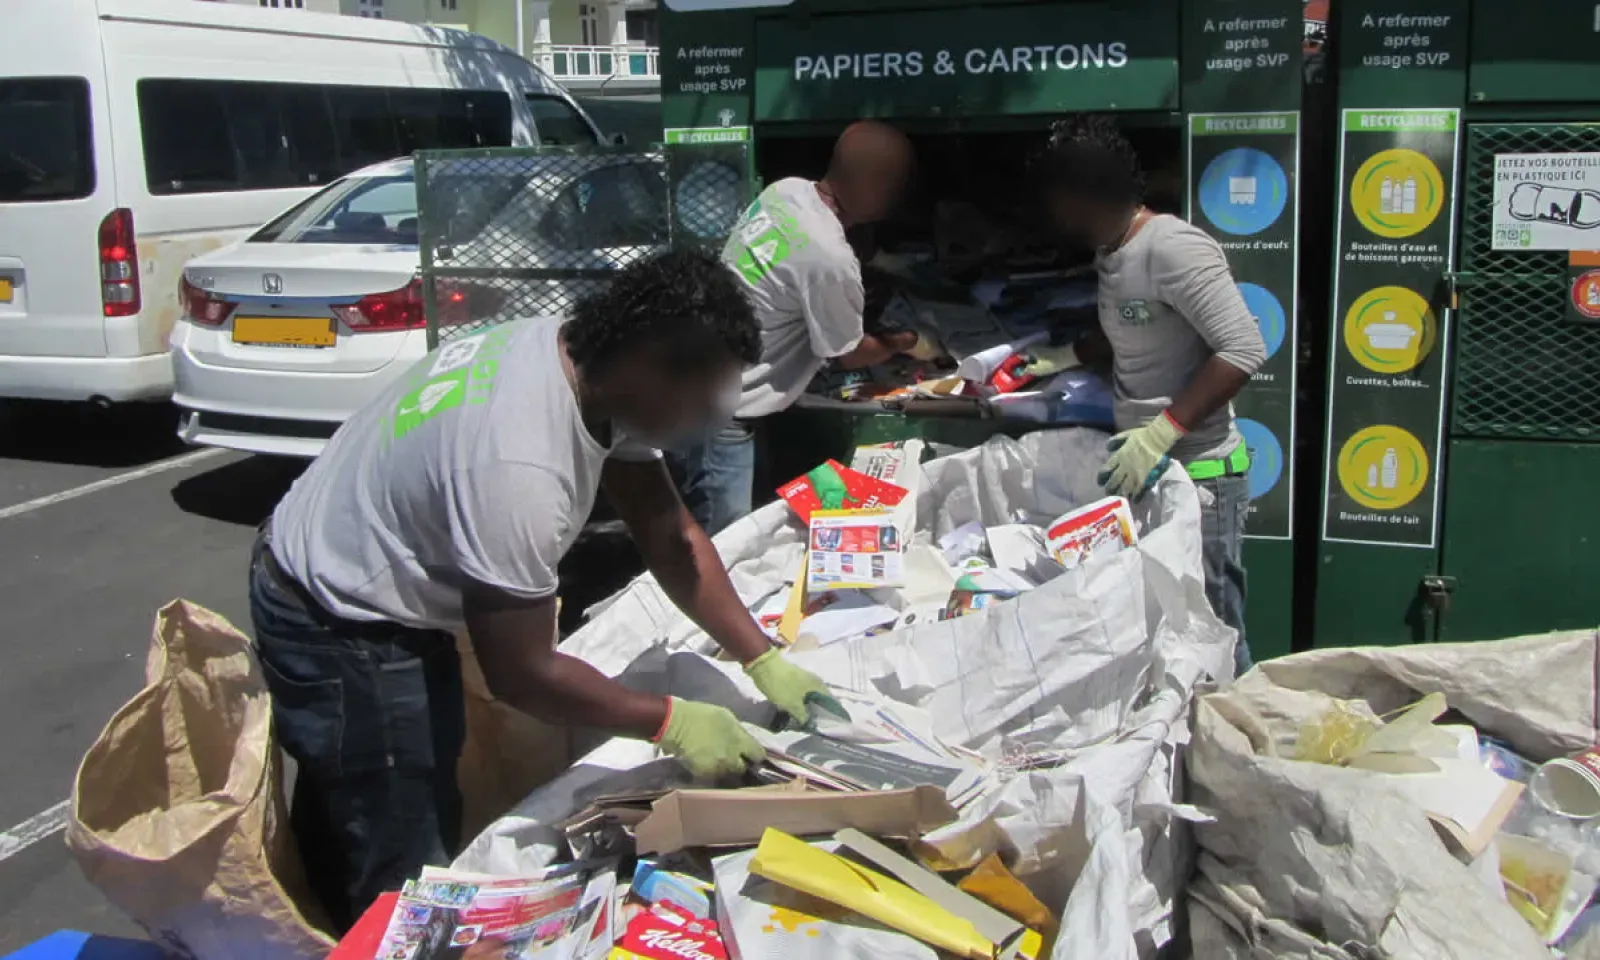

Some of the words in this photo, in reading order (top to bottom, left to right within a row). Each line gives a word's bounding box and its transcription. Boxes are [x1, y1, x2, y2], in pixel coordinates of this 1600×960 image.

[1203, 18, 1215, 33] A
[1218, 17, 1288, 32] refermer
[1361, 14, 1375, 28] A
[1378, 13, 1451, 28] refermer
[1225, 36, 1270, 52] après
[1383, 33, 1430, 48] après
[677, 47, 687, 59] A
[689, 46, 744, 58] refermer
[794, 51, 923, 81] PAPIERS
[933, 49, 955, 76] &
[964, 42, 1128, 75] CARTONS
[1205, 58, 1253, 72] usage
[1256, 53, 1290, 67] SVP
[1362, 55, 1411, 69] usage
[1415, 52, 1450, 65] SVP
[694, 62, 731, 77] après
[680, 82, 717, 94] usage
[719, 78, 747, 91] SVP
[1205, 117, 1287, 131] RECYCLABLES
[1361, 114, 1447, 128] RECYCLABLES
[1498, 159, 1526, 168] JETEZ
[1529, 159, 1547, 168] VOS
[1551, 158, 1600, 167] BOUTEILL
[1497, 172, 1510, 181] EN
[1512, 171, 1566, 181] PLASTIQUE
[1570, 171, 1586, 181] ICI
[1351, 242, 1398, 252] Bouteilles
[1400, 243, 1426, 252] d'eau
[1428, 244, 1438, 252] et
[1344, 252, 1357, 261] de
[1358, 252, 1398, 262] boissons
[1401, 255, 1443, 264] gazeuses
[1346, 375, 1391, 387] Cuvettes,
[1340, 511, 1387, 522] Bouteilles
[1389, 513, 1402, 524] de
[1403, 515, 1419, 525] lait
